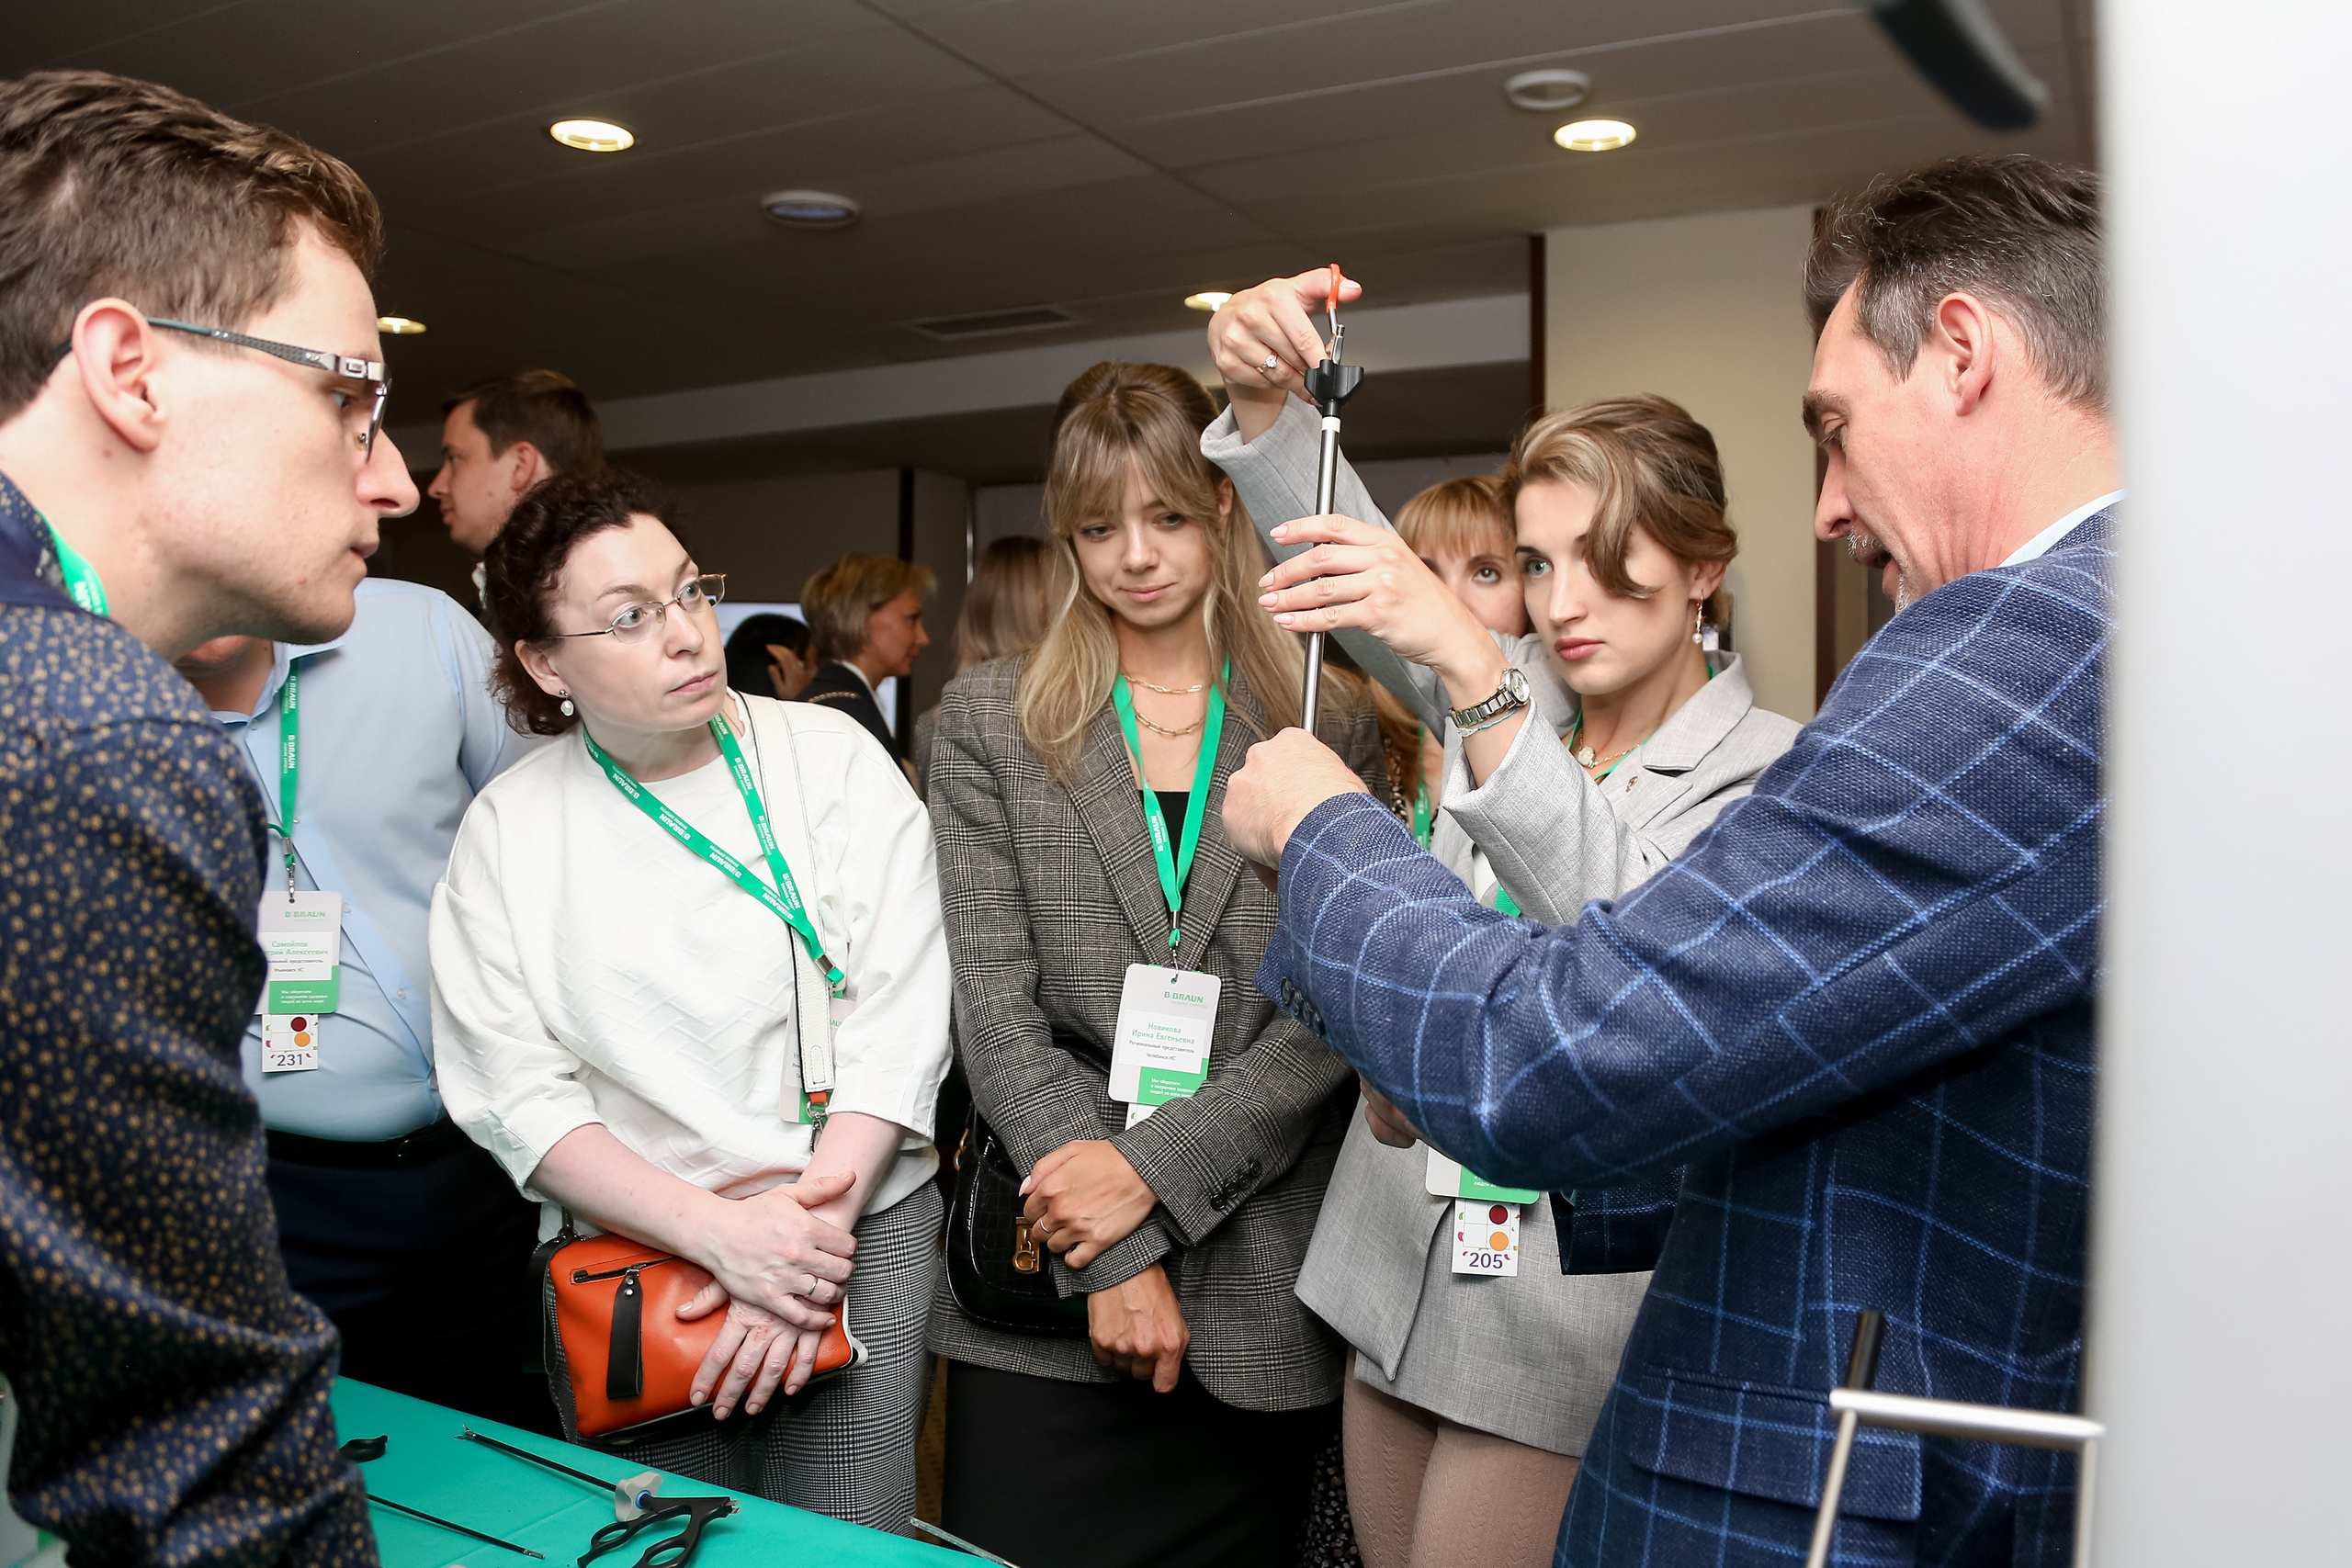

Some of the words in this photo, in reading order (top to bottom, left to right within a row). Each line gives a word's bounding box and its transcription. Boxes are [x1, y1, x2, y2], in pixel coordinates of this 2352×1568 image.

[1172, 993, 1204, 1003] BRAUN
[1148, 1022, 1182, 1033] Новикова
[1132, 1029, 1154, 1038] Ирина
[1157, 1032, 1194, 1043] Евгеньевна
[277, 1054, 302, 1066] 231
[1469, 1252, 1503, 1269] 205
